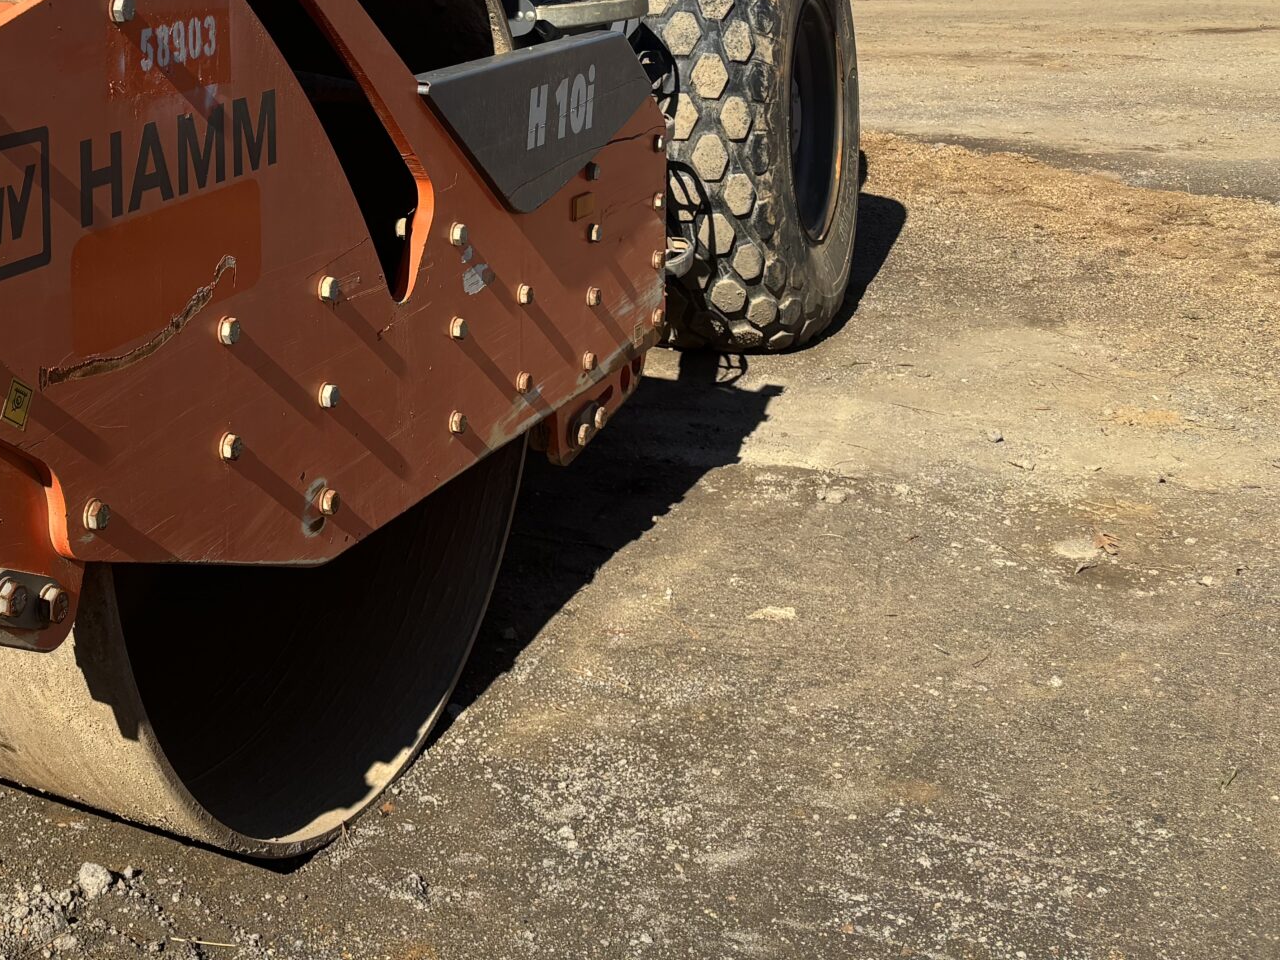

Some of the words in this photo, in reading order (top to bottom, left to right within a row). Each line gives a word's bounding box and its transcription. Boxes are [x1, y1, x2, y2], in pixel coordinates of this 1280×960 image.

[140, 15, 216, 72] 58903
[527, 83, 549, 151] H
[555, 63, 596, 140] 10i
[79, 88, 277, 228] HAMM
